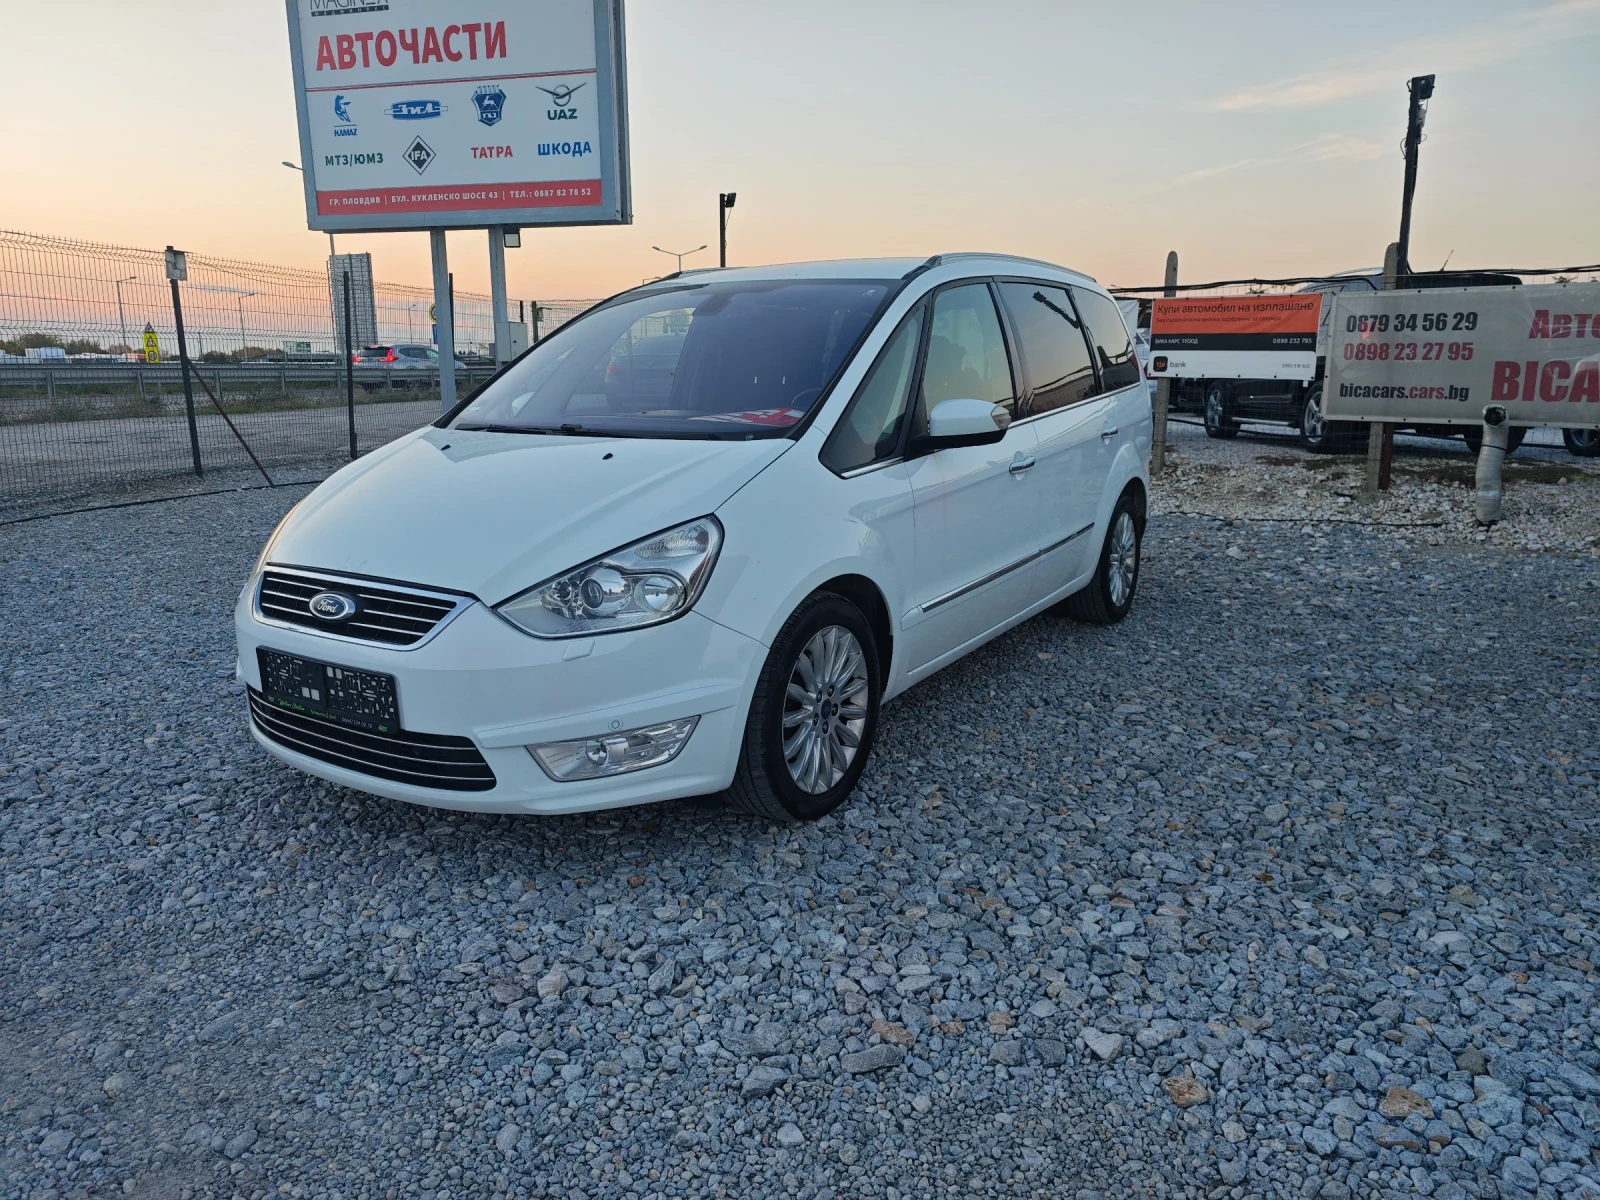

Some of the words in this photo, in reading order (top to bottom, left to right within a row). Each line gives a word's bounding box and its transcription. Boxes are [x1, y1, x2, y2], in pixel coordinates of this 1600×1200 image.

[316, 21, 507, 71] АВТОЧАСТИ
[547, 108, 578, 121] UAZ
[334, 128, 358, 137] KAMAZ
[410, 150, 428, 161] IFA
[471, 145, 514, 159] ТАТРА
[537, 141, 592, 157] ШКОДА
[325, 152, 384, 167] МТЗ/ЮМЗ
[342, 196, 381, 206] ПЛОВДИВ
[391, 194, 410, 203] БУЛ.
[411, 192, 460, 202] КУКЛЕНСКО
[462, 191, 486, 200] ШОСЕ
[488, 191, 498, 199] 43
[509, 189, 532, 198] ТЕЛ.:
[534, 189, 554, 197] 0887
[556, 188, 567, 196] 82
[568, 188, 579, 196] 78
[581, 187, 592, 196] 52
[1157, 304, 1180, 316] Купи
[1181, 303, 1236, 314] автомобил
[1238, 303, 1251, 312] на
[1253, 301, 1315, 312] изплащане
[1346, 313, 1390, 333] 0879
[1393, 313, 1418, 333] 34
[1422, 312, 1449, 332] 56
[1451, 311, 1479, 332] 29
[1343, 342, 1391, 361] 0898
[1393, 342, 1418, 361] 23
[1421, 342, 1445, 361] 27
[1447, 341, 1474, 361] 95
[1339, 383, 1470, 402] bicacars.cars.bg
[317, 598, 339, 613] Ford
